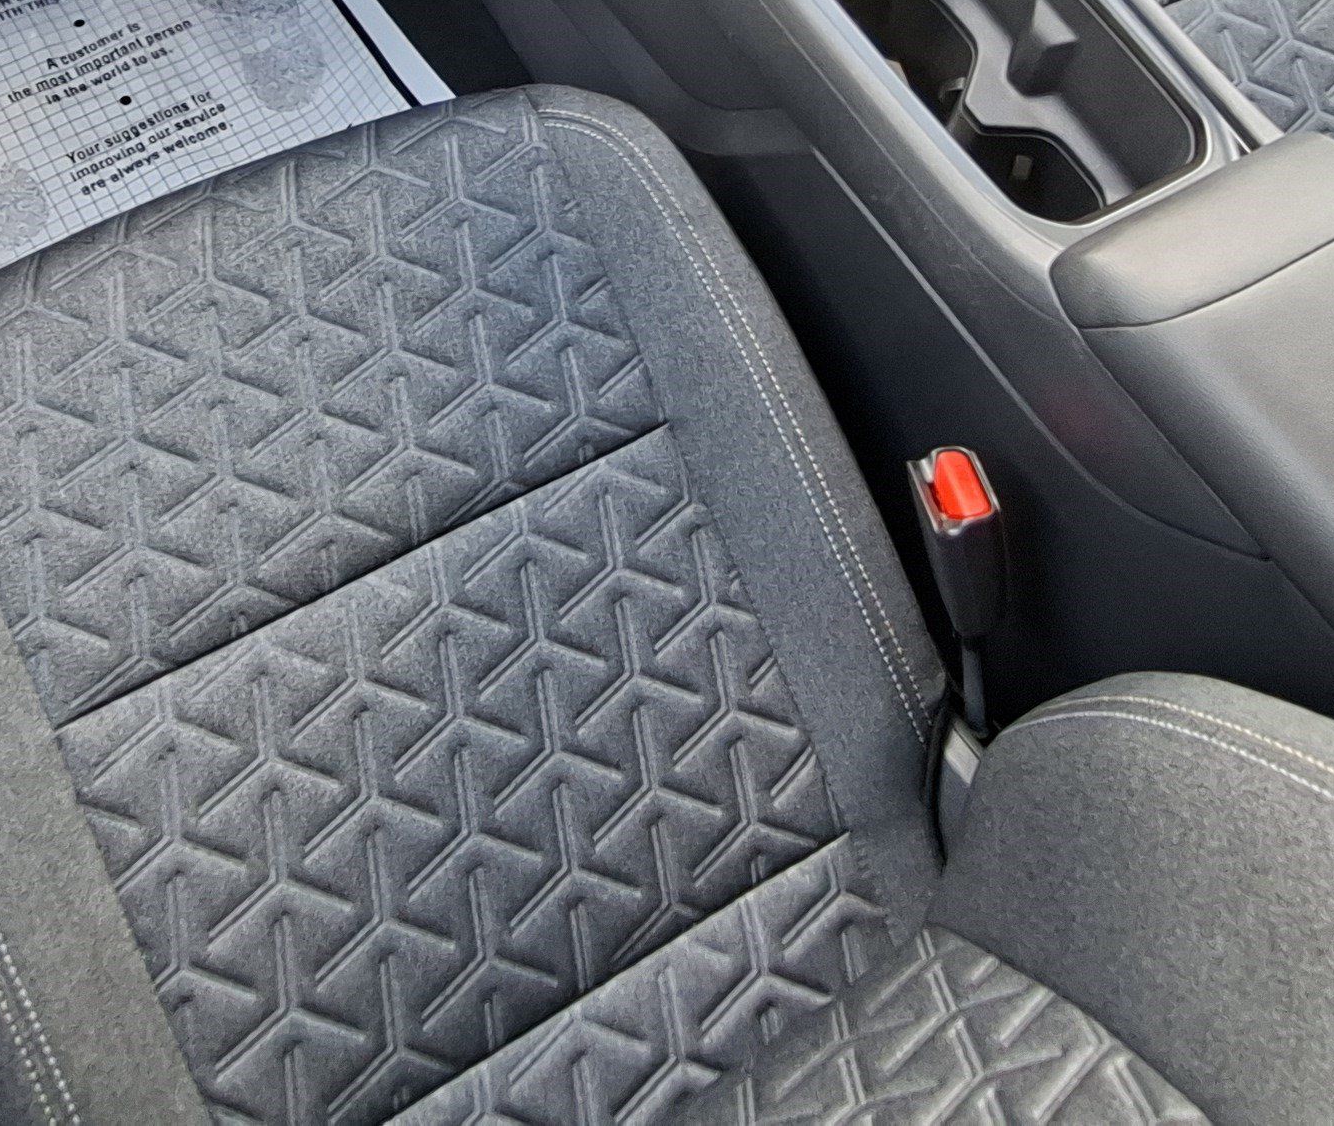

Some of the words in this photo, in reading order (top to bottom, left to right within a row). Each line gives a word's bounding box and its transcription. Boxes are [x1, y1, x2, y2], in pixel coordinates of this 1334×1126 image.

[7, 86, 32, 104] the
[35, 71, 73, 93] most
[75, 37, 143, 77] important
[145, 20, 193, 47] person
[46, 57, 58, 70] A
[60, 29, 124, 65] customer
[64, 82, 88, 98] the
[90, 61, 131, 86] world
[132, 54, 148, 67] to
[66, 142, 100, 164] Your
[104, 101, 190, 148] suggestions
[190, 90, 213, 106] for
[69, 141, 146, 183] improving
[148, 127, 172, 145] our
[174, 102, 226, 131] service
[81, 177, 107, 196] are
[110, 151, 160, 183] always
[163, 121, 234, 155] welcome.
